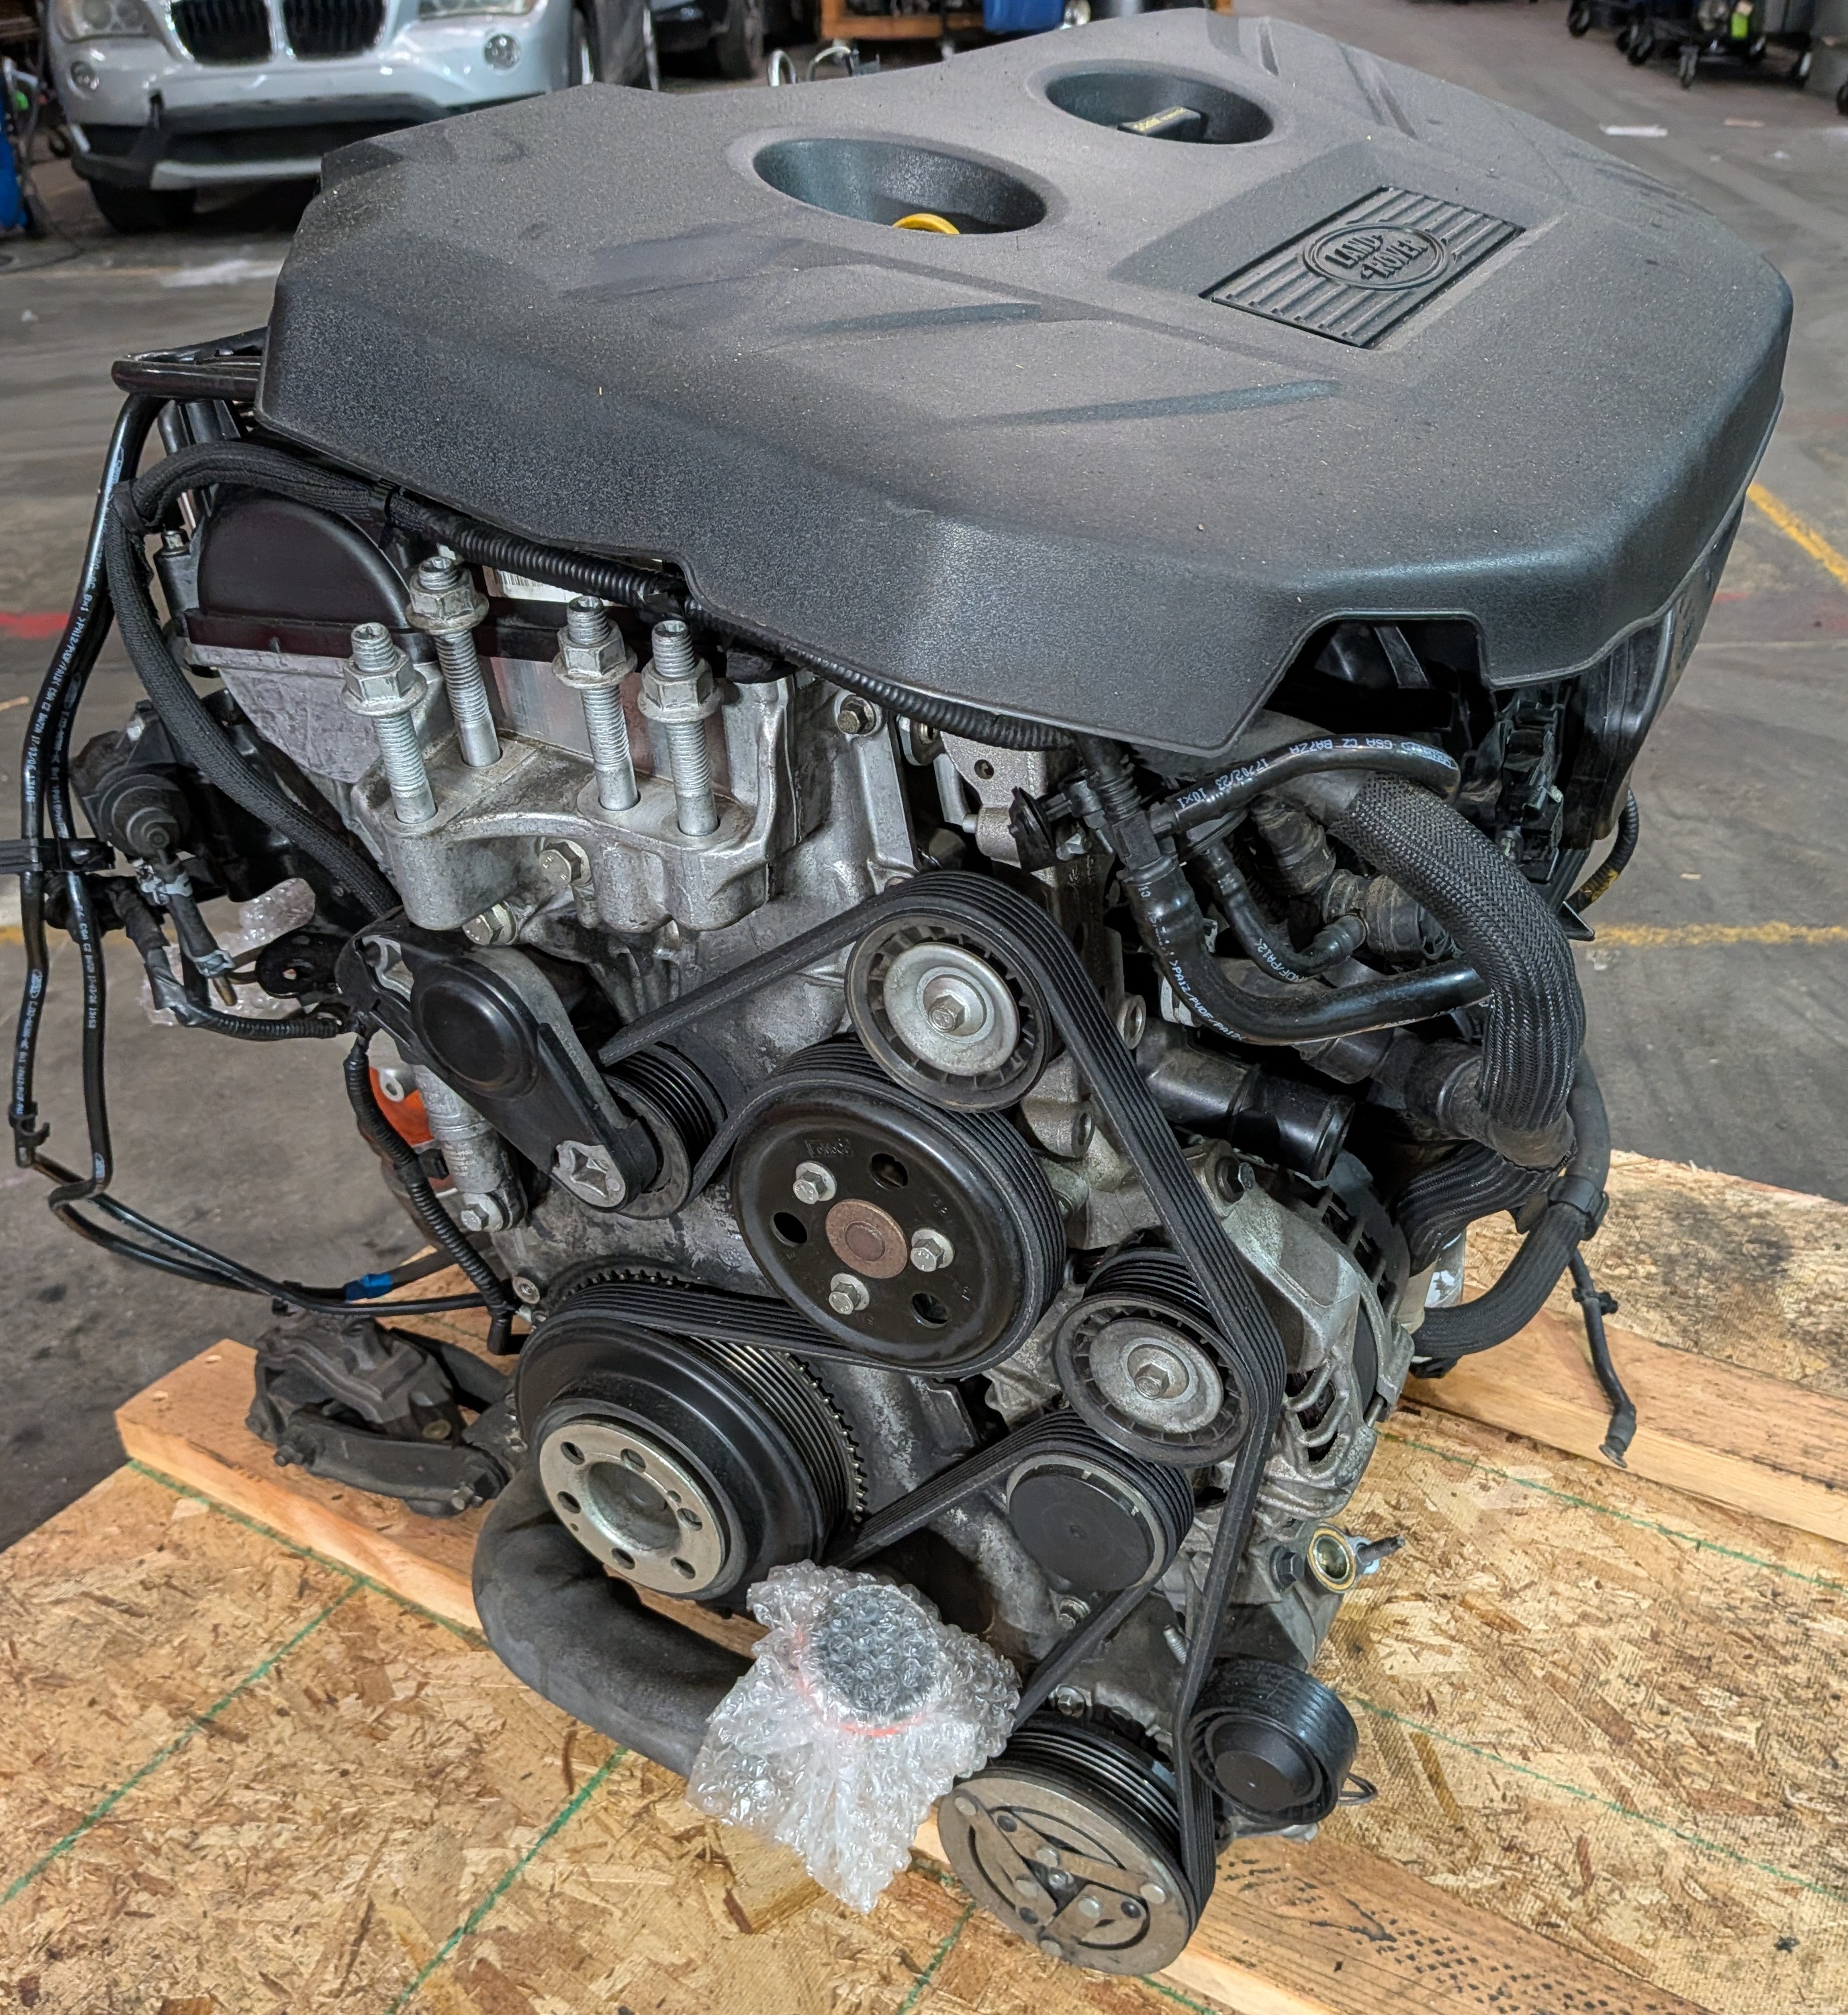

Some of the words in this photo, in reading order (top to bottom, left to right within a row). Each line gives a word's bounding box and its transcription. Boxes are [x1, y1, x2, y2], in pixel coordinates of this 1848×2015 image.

[1325, 234, 1383, 269] LAND
[1363, 239, 1429, 279] ROVER
[1341, 737, 1357, 748] CZ
